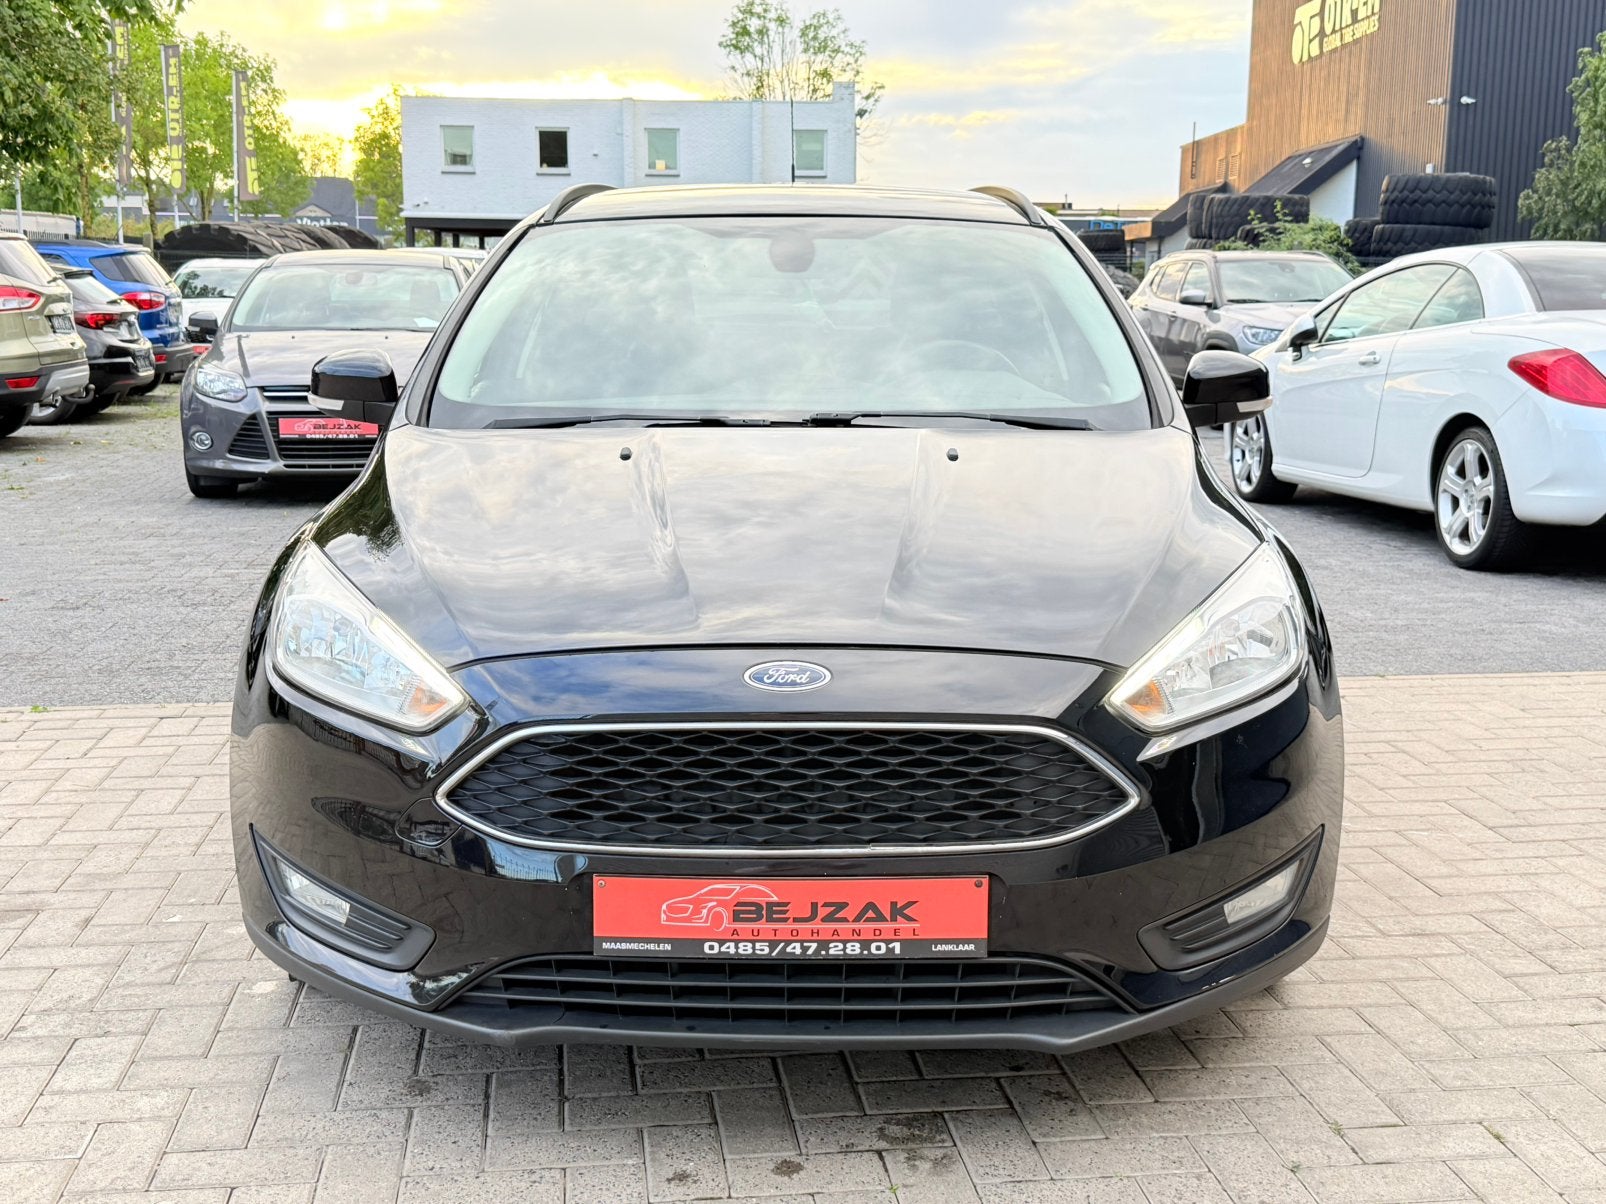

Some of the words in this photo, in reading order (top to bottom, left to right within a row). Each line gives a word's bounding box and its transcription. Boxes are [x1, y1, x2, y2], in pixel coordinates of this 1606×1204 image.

[763, 667, 811, 683] Ford
[732, 901, 920, 924] BEJZAK
[731, 928, 920, 938] AUTOHANDEL
[602, 942, 672, 951] MAASMECHELEN
[703, 941, 901, 957] 0485/47.28.01
